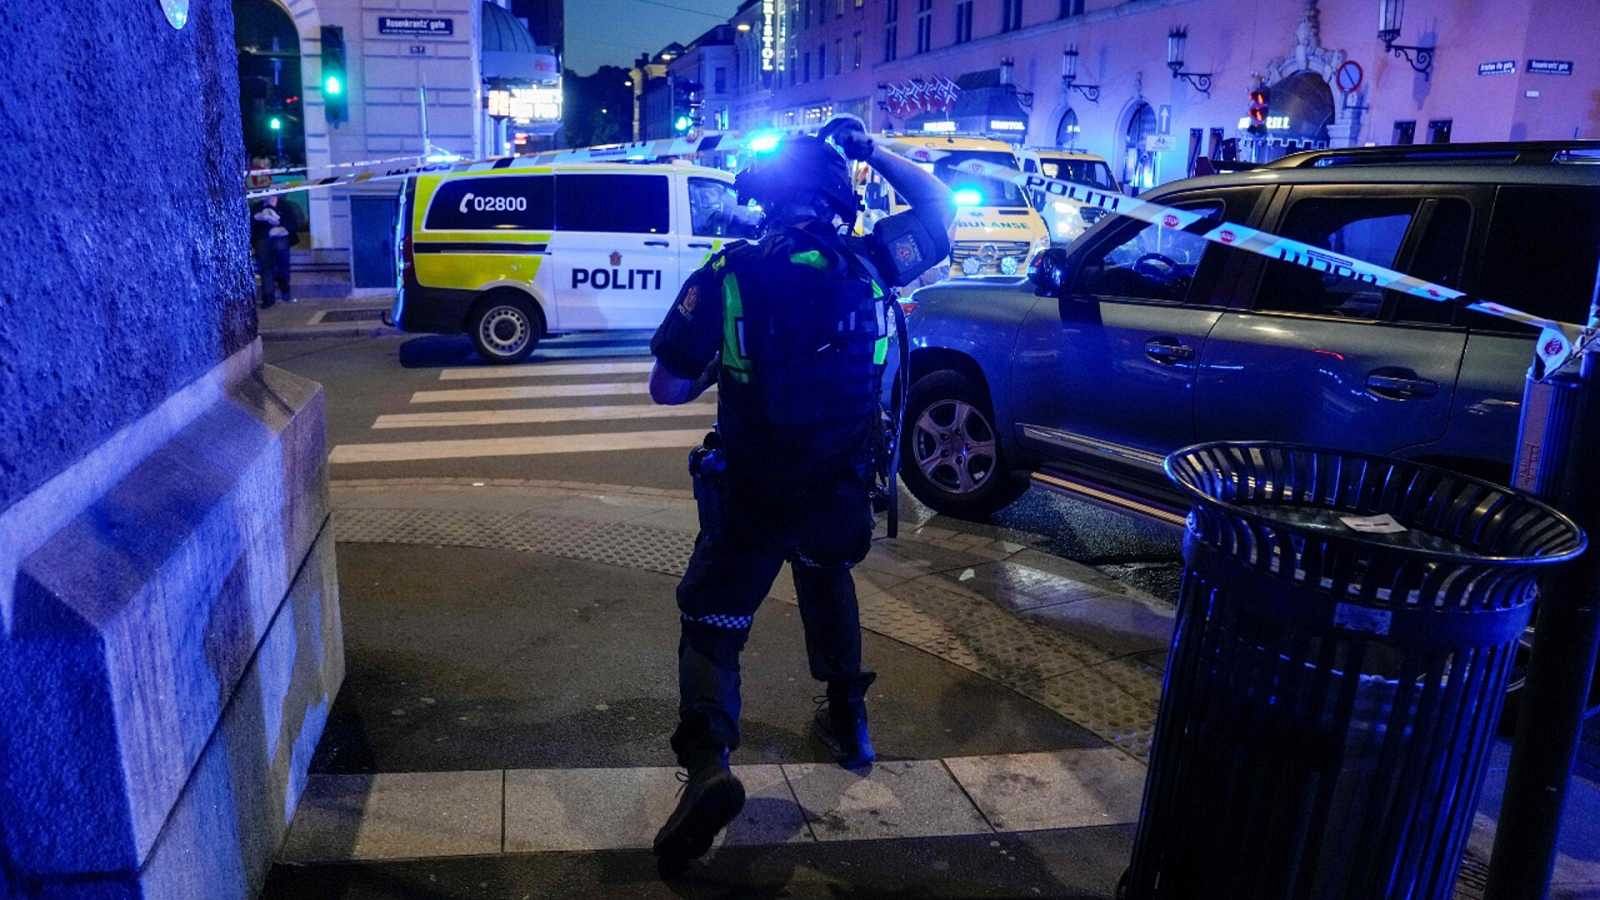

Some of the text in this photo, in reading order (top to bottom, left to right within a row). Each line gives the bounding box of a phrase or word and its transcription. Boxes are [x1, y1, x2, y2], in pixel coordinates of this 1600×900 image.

[430, 20, 446, 30] gate
[762, 0, 774, 71] RISTOL
[1026, 175, 1119, 212] POLITI
[474, 196, 527, 212] 02800
[954, 221, 1031, 230] BULANSE
[571, 268, 661, 290] POLITI
